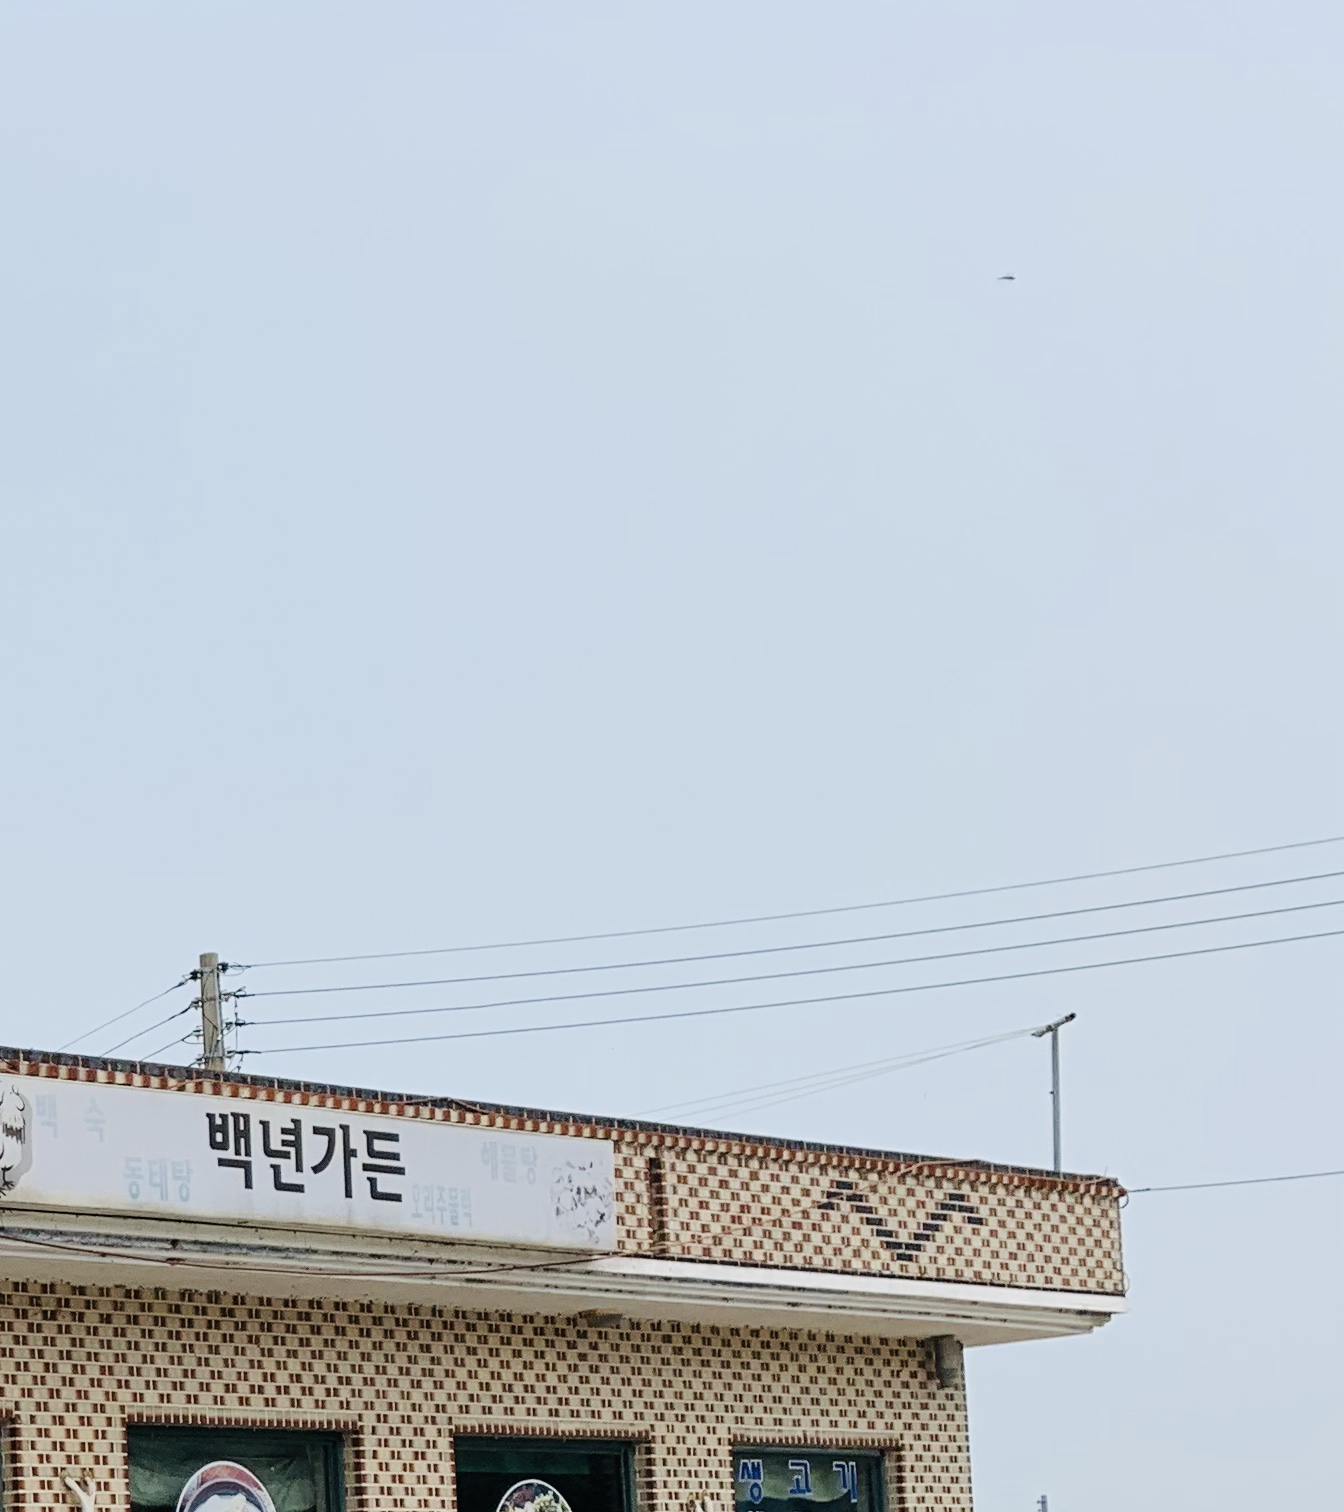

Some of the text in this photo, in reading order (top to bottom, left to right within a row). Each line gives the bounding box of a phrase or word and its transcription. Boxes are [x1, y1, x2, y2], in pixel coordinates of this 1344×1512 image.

[123, 1156, 193, 1202] 동태탕
[206, 1112, 406, 1202] 백년가든
[480, 1141, 538, 1185] 해물탕
[738, 1459, 858, 1504] 생고기
